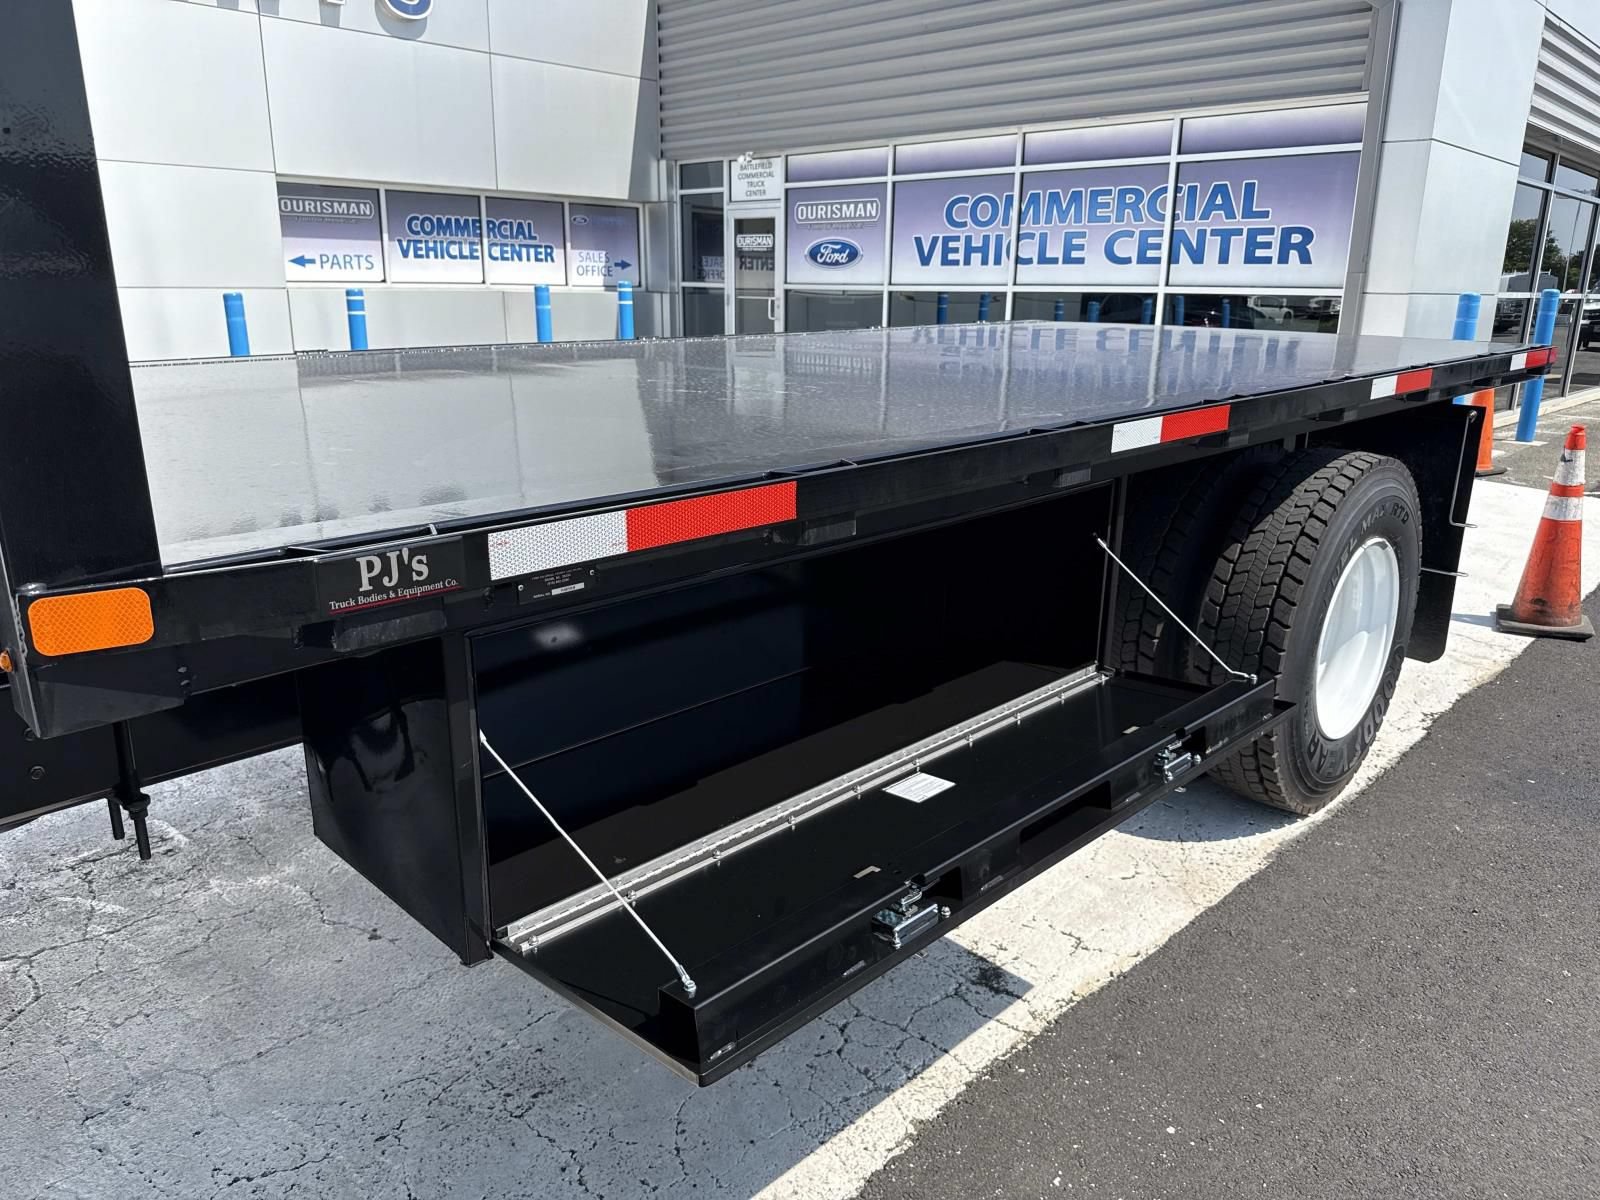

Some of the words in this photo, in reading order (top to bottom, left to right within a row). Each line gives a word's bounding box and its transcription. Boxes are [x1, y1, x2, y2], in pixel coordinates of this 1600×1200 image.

[738, 171, 775, 180] COMMERCIAL
[747, 180, 765, 188] TRUCK
[745, 189, 766, 197] CENTER
[281, 199, 370, 215] OURISMAN
[798, 202, 876, 219] OURISMAN
[945, 181, 1270, 229] COMMERCIAL
[406, 215, 538, 241] COMMERCIAL
[738, 236, 772, 247] OURISMAN
[914, 229, 1088, 267] VEHICLE
[1103, 225, 1315, 266] CENTER
[397, 239, 480, 260] VEHICLE
[488, 242, 555, 263] CENTER
[578, 251, 610, 264] SALES
[816, 243, 850, 264] Ford
[319, 254, 374, 270] PARTS
[577, 265, 613, 277] OFFICE
[356, 547, 429, 592] PJ's
[329, 598, 356, 610] Truck
[358, 593, 388, 605] Bodies
[389, 590, 396, 598] &
[398, 580, 443, 598] Equipment
[445, 578, 459, 587] Co.
